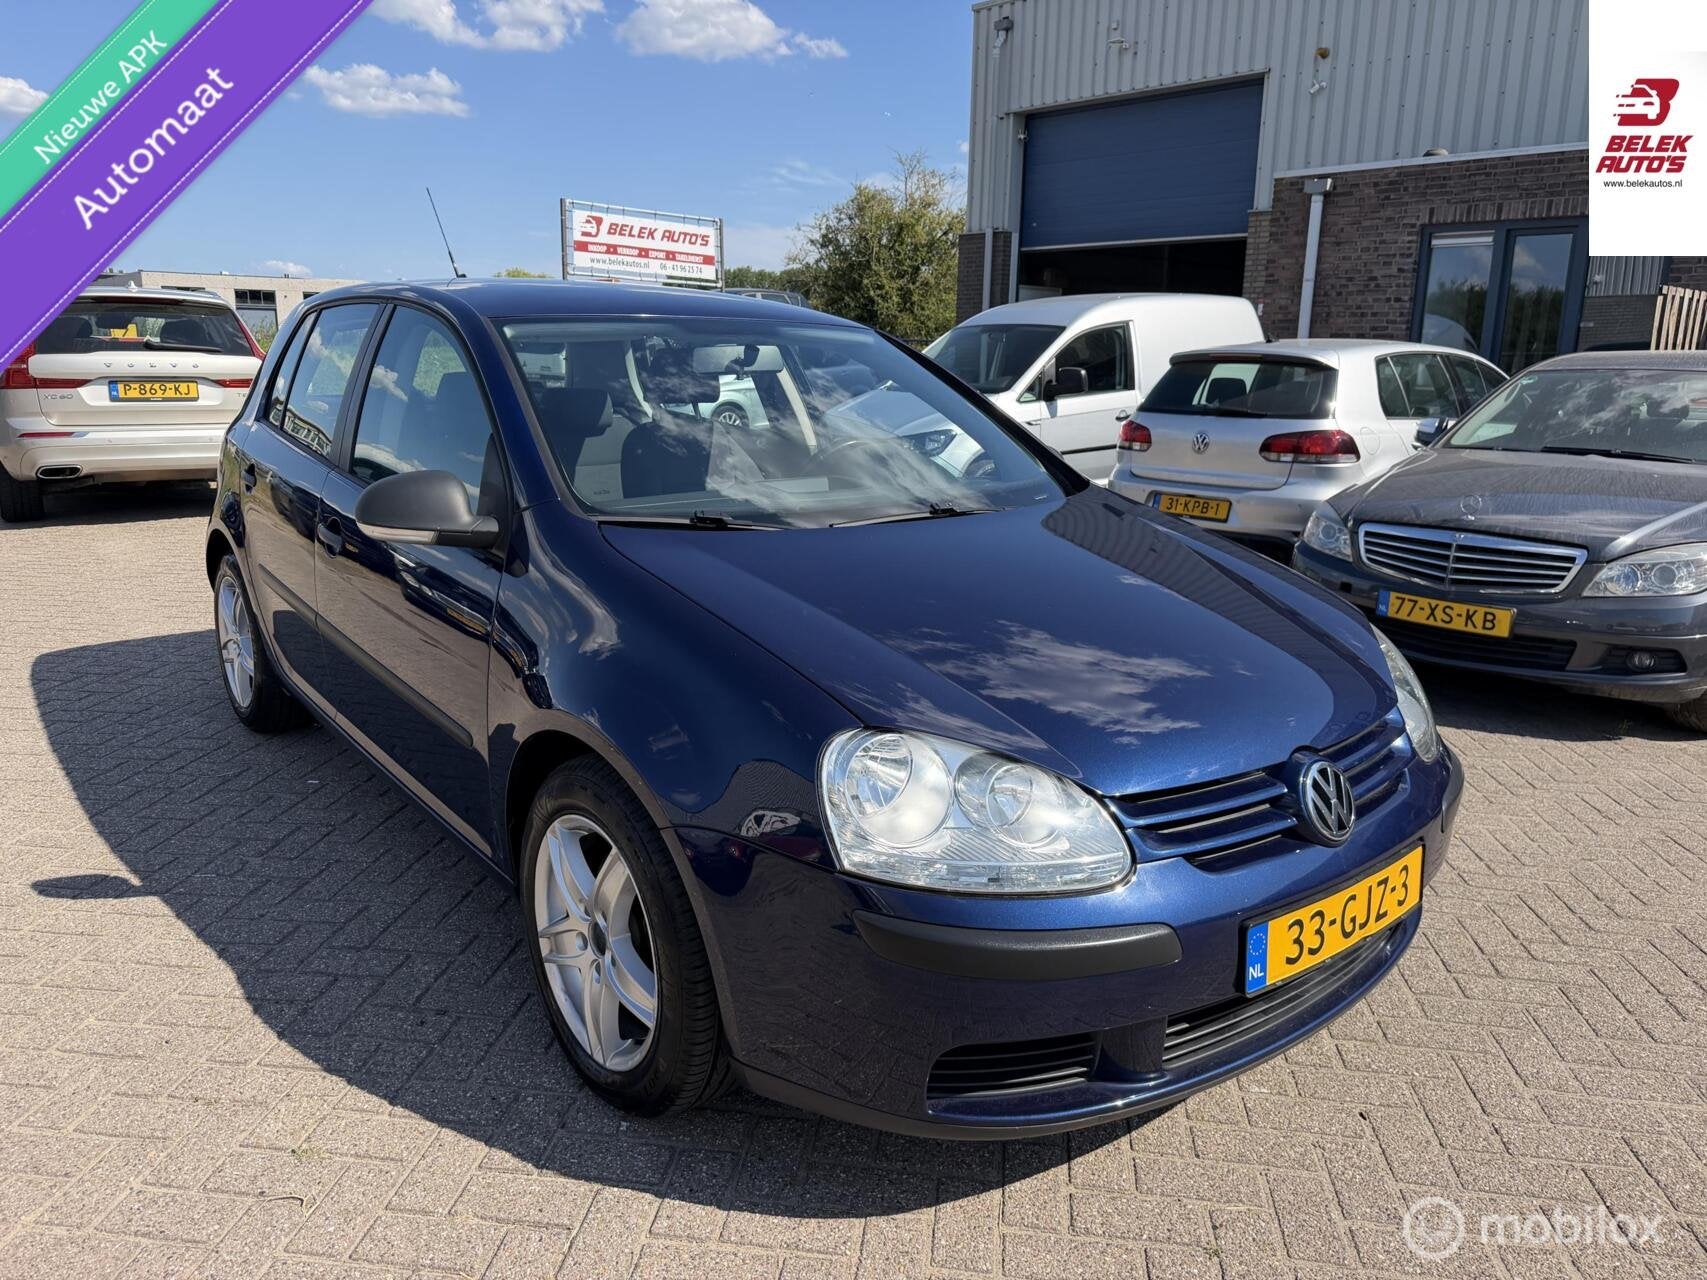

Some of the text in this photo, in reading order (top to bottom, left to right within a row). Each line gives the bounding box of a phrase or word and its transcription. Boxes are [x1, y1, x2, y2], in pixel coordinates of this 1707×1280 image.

[607, 222, 710, 247] BELEK AUTO'S
[590, 256, 650, 269] www.belekautos.nl
[123, 383, 190, 396] P-869-KJ
[1166, 497, 1219, 516] 31-KPB-1
[1394, 596, 1497, 631] 77-XS-KB
[1249, 864, 1409, 981] NL 33-GJZ-3
